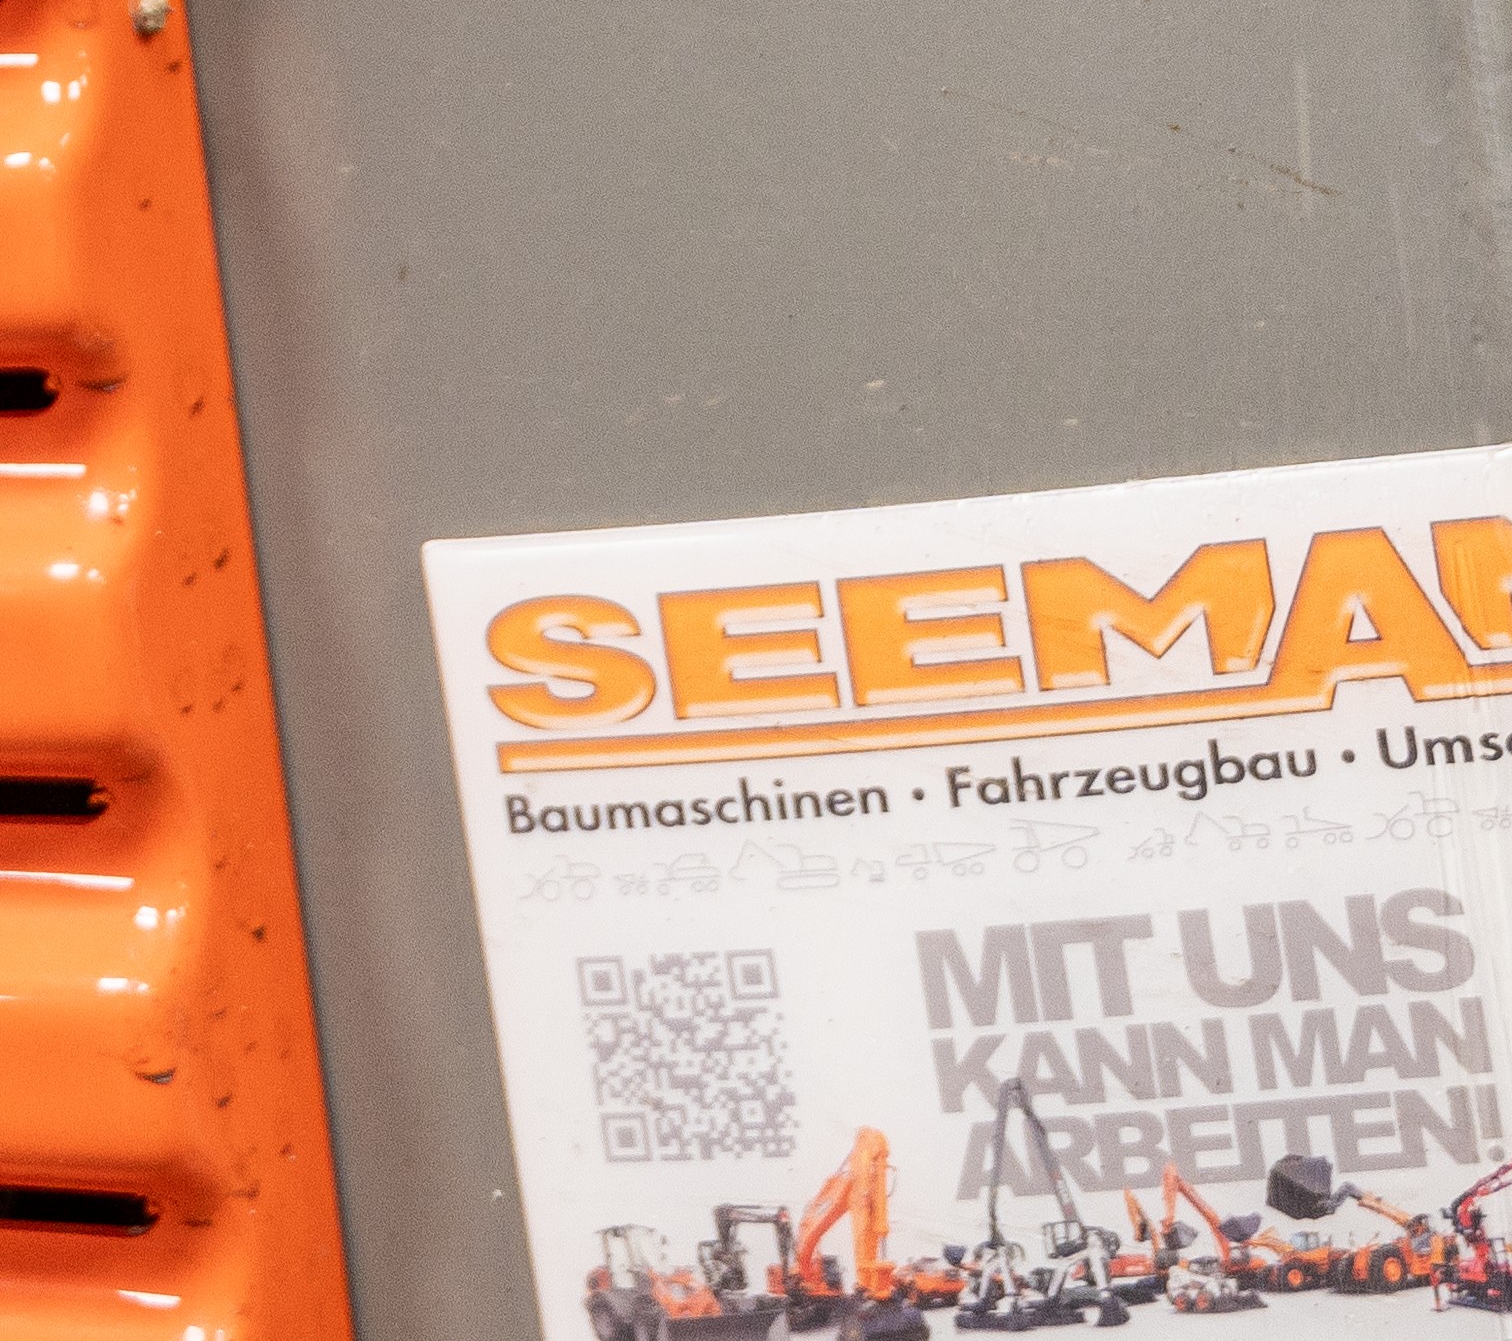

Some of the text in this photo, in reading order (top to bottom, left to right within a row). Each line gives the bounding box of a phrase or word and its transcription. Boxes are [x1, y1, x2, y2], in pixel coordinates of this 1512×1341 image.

[504, 777, 890, 836] Baumaschinen
[947, 738, 1319, 809] Fahrzeugbau
[914, 888, 1477, 1030] MIT UNS
[930, 997, 1493, 1114] KANN MAN
[955, 1084, 1508, 1202] ARBEITEN!
